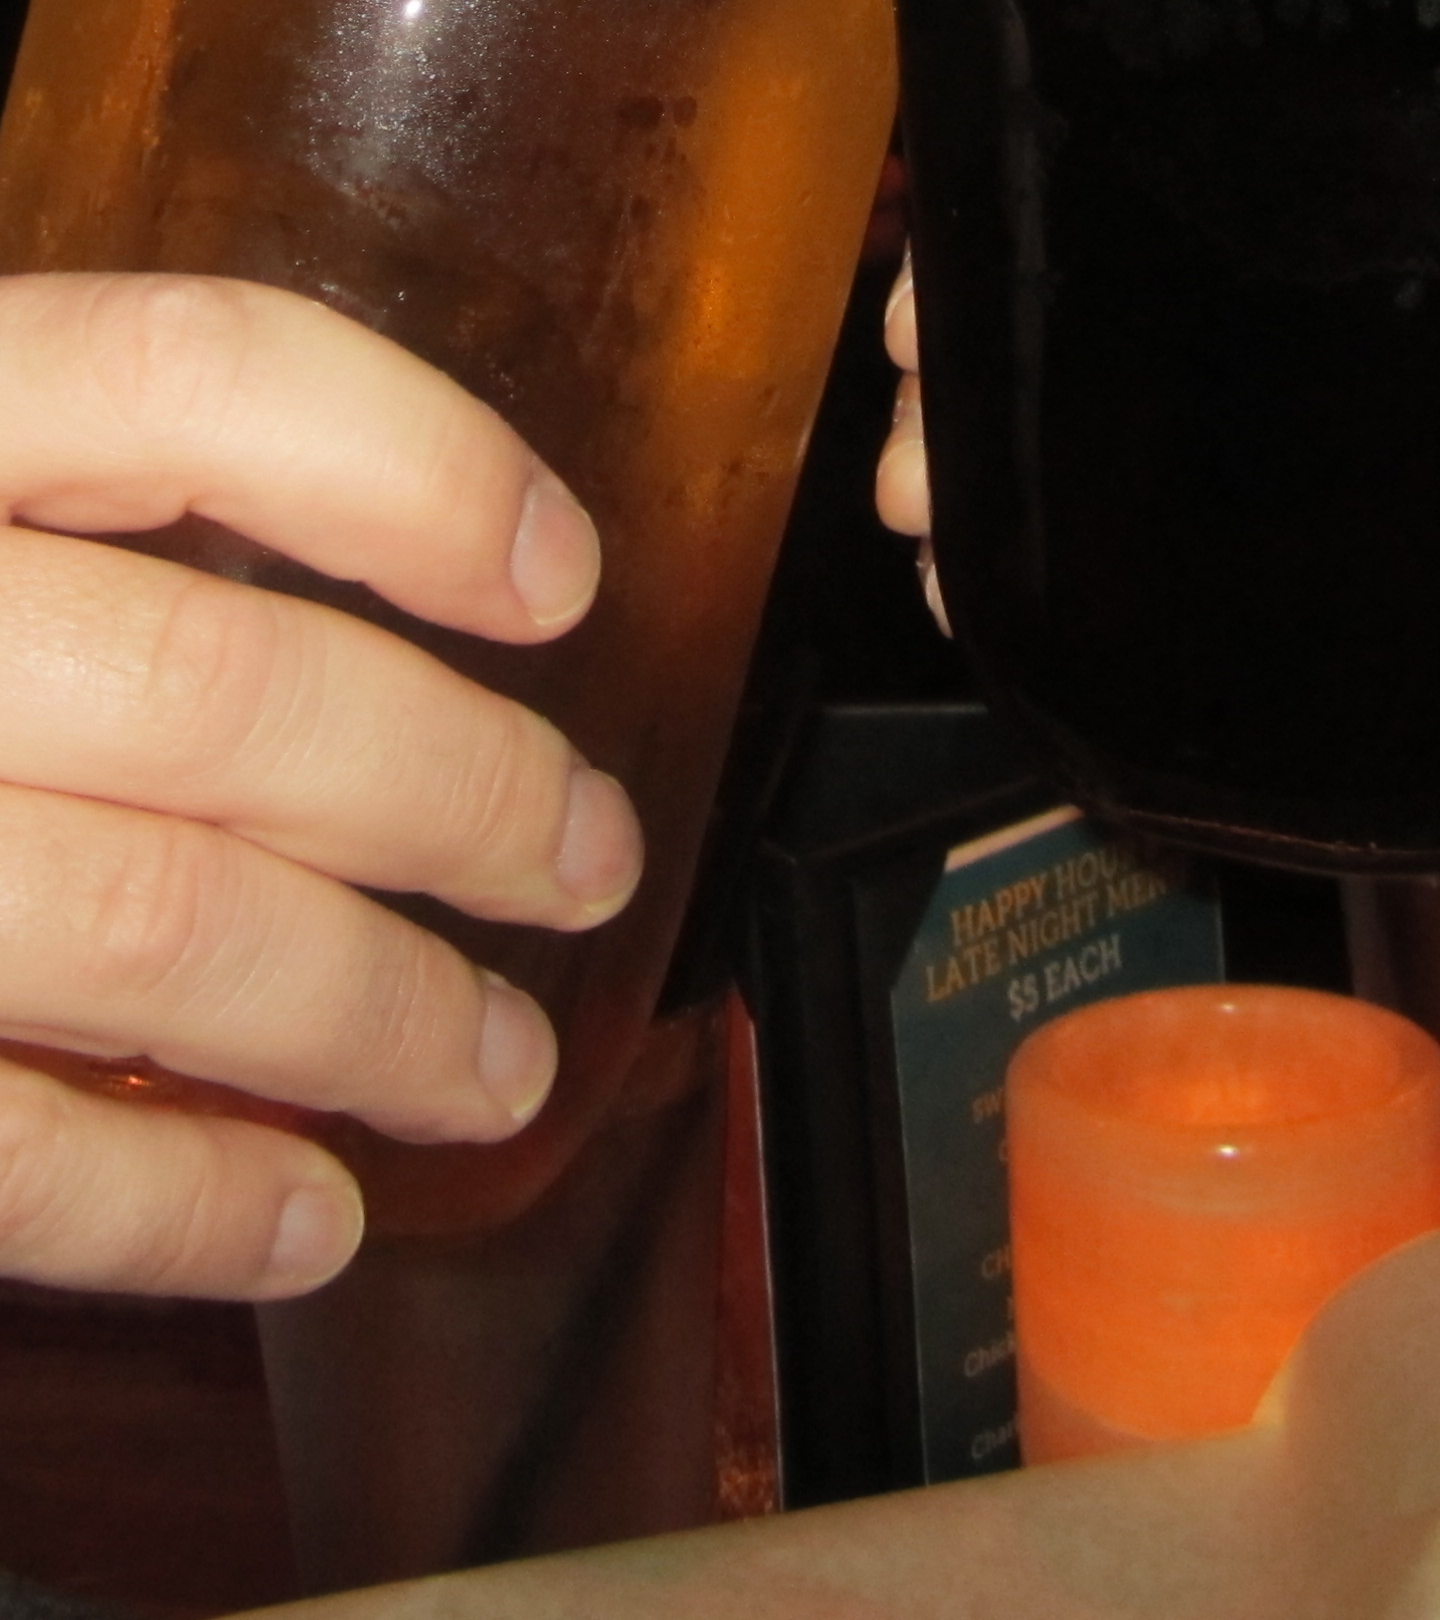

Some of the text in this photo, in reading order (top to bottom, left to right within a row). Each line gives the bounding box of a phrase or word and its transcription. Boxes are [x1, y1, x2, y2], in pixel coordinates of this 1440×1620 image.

[950, 871, 1048, 947] HAPPY
[925, 938, 1000, 1005] LATE
[1006, 891, 1099, 966] NIGHT
[1044, 933, 1122, 1004] EACH
